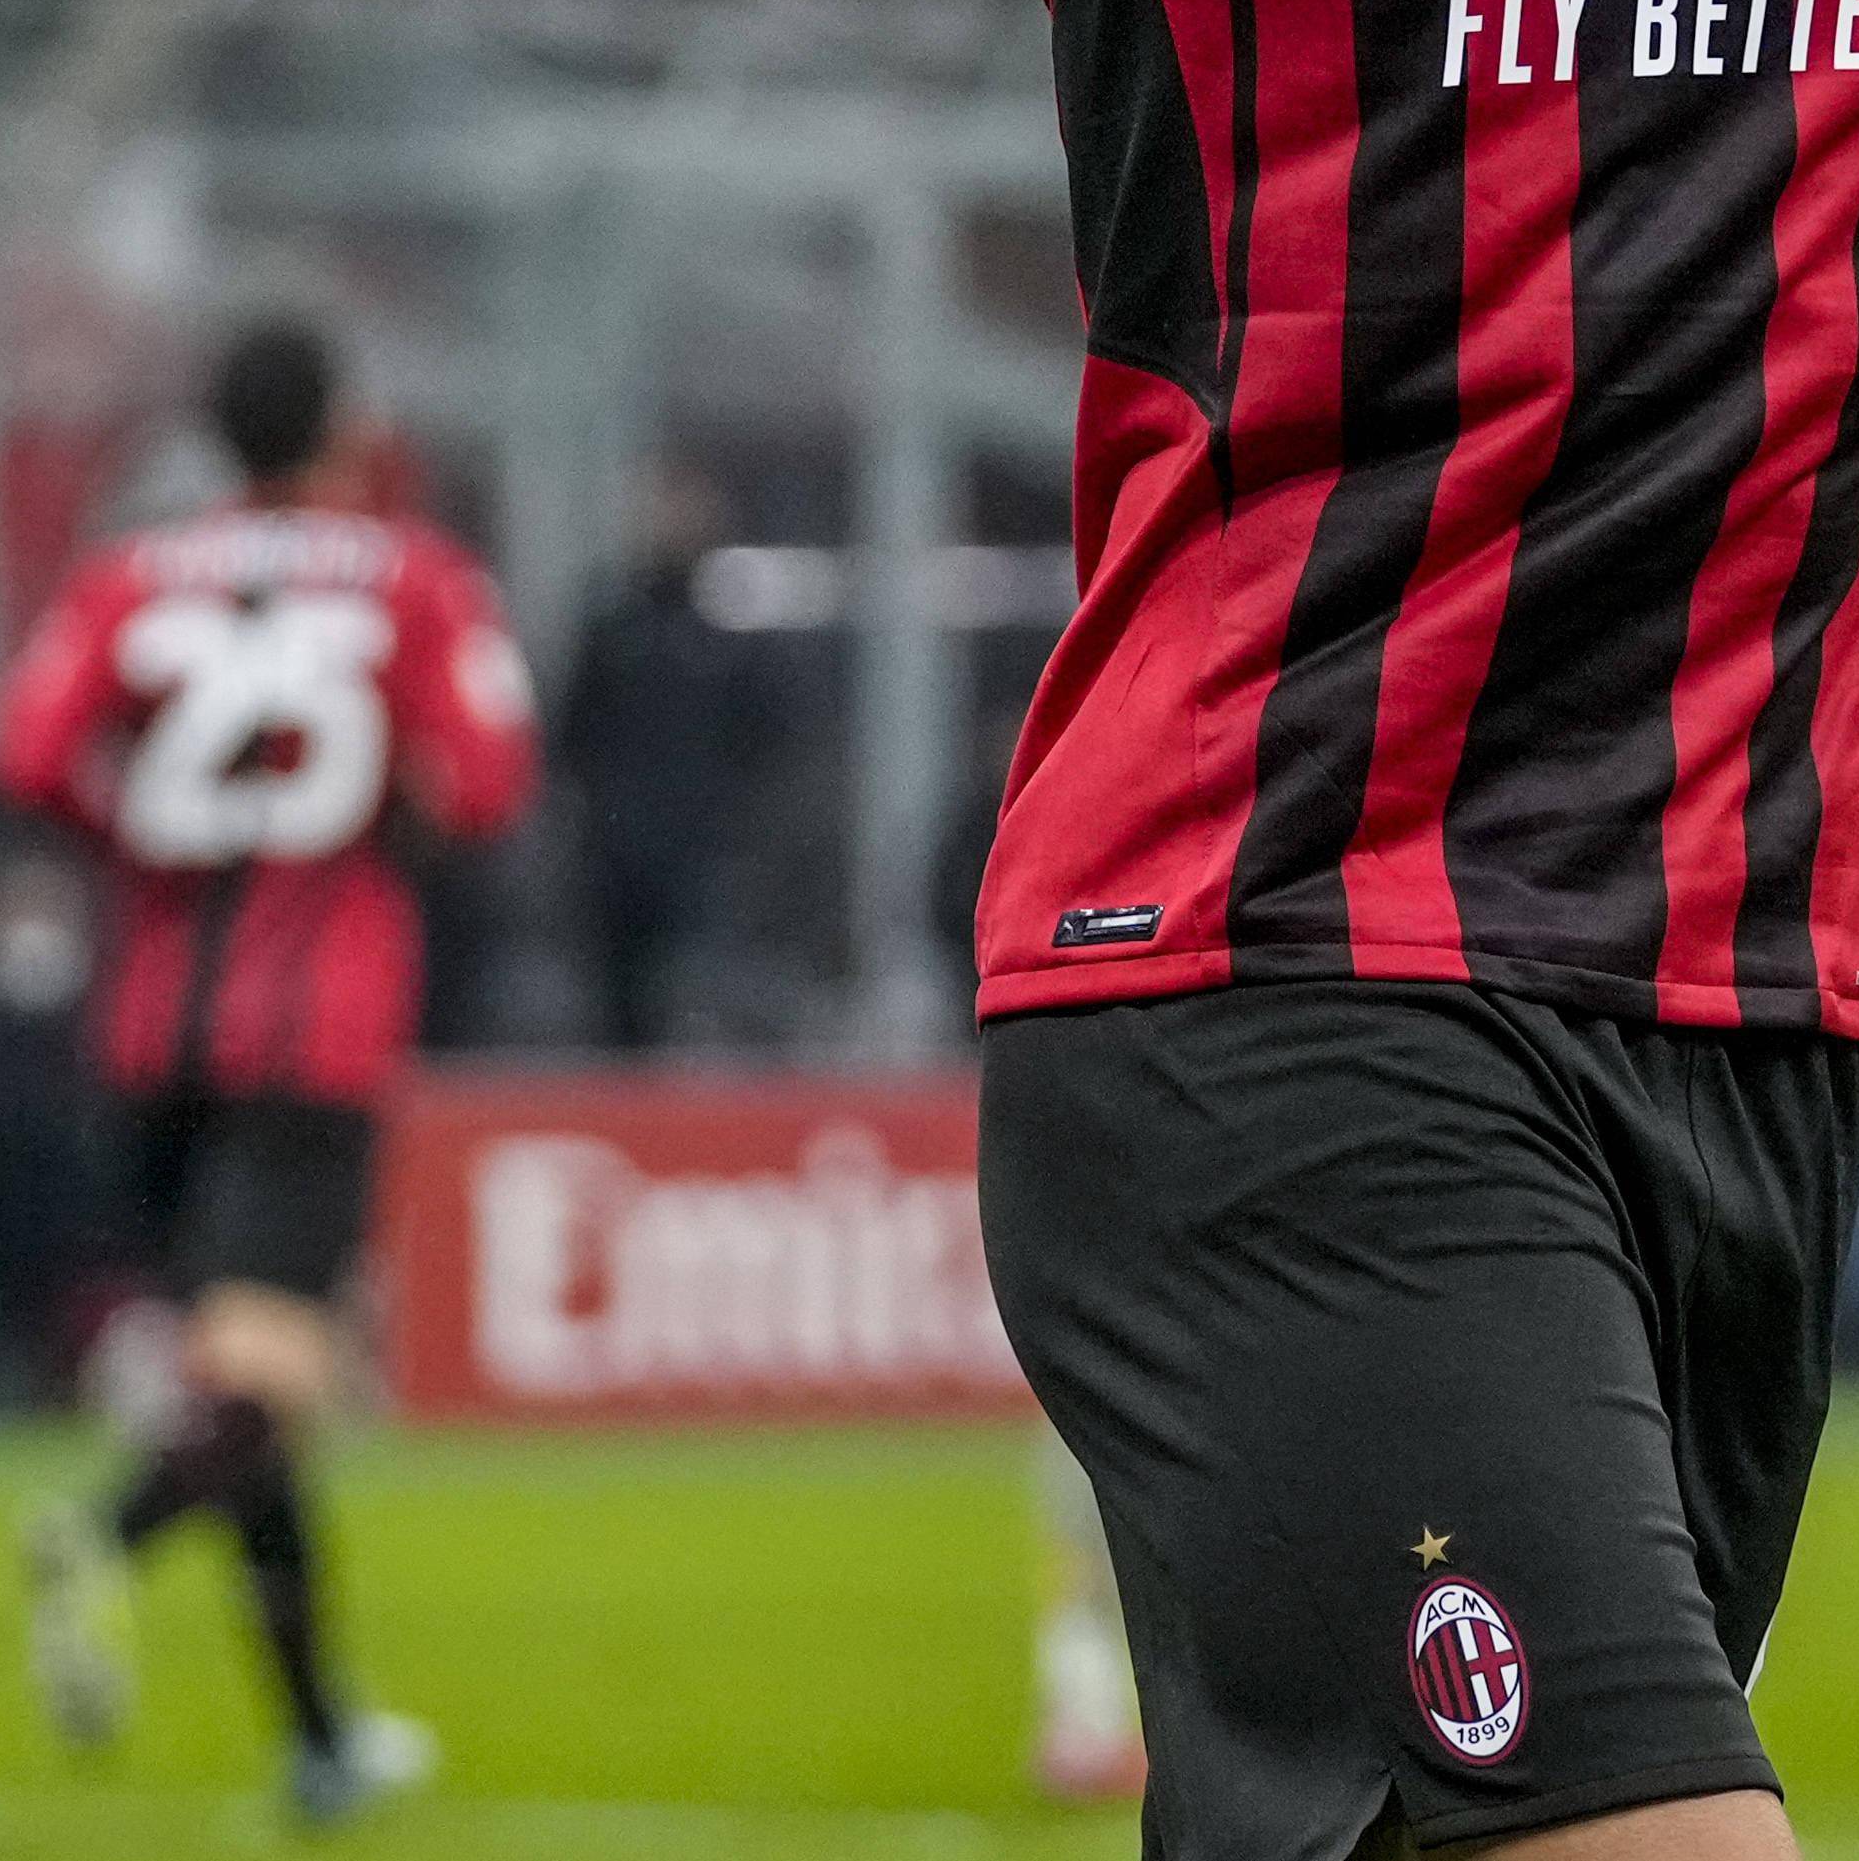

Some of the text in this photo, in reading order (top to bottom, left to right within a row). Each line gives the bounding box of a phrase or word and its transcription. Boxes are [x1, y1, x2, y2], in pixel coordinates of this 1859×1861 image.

[115, 592, 398, 869] 25
[1424, 1591, 1486, 1634] ACM
[1456, 1715, 1511, 1745] 1899
